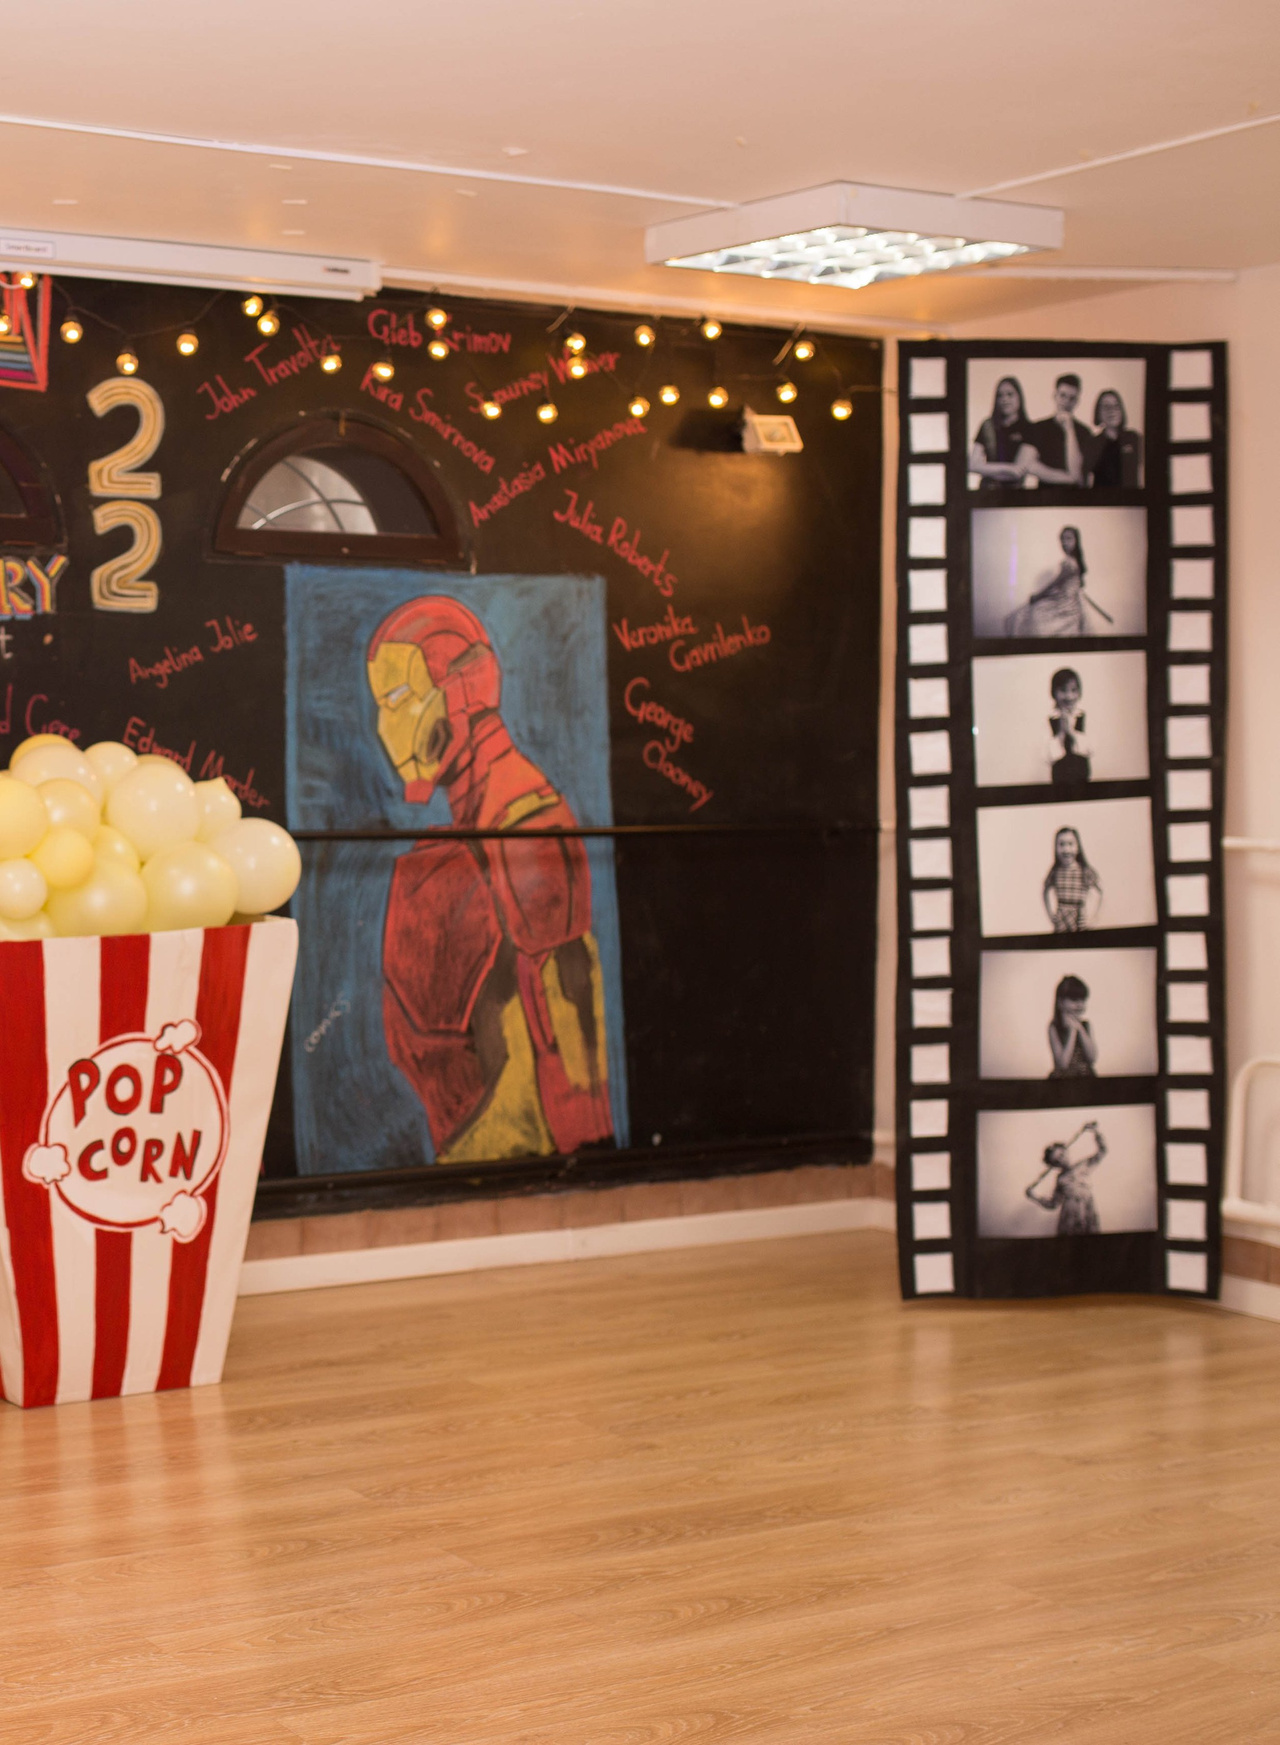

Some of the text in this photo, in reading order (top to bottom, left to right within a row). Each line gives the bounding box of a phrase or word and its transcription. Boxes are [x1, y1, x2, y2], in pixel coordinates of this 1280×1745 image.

[196, 373, 257, 421] John
[552, 487, 679, 598] Julia Roberts
[128, 615, 259, 689] Angelina Jolie
[623, 676, 695, 752] George
[642, 740, 716, 812] Clooney
[68, 1053, 183, 1129] POP
[77, 1125, 203, 1185] CORN
